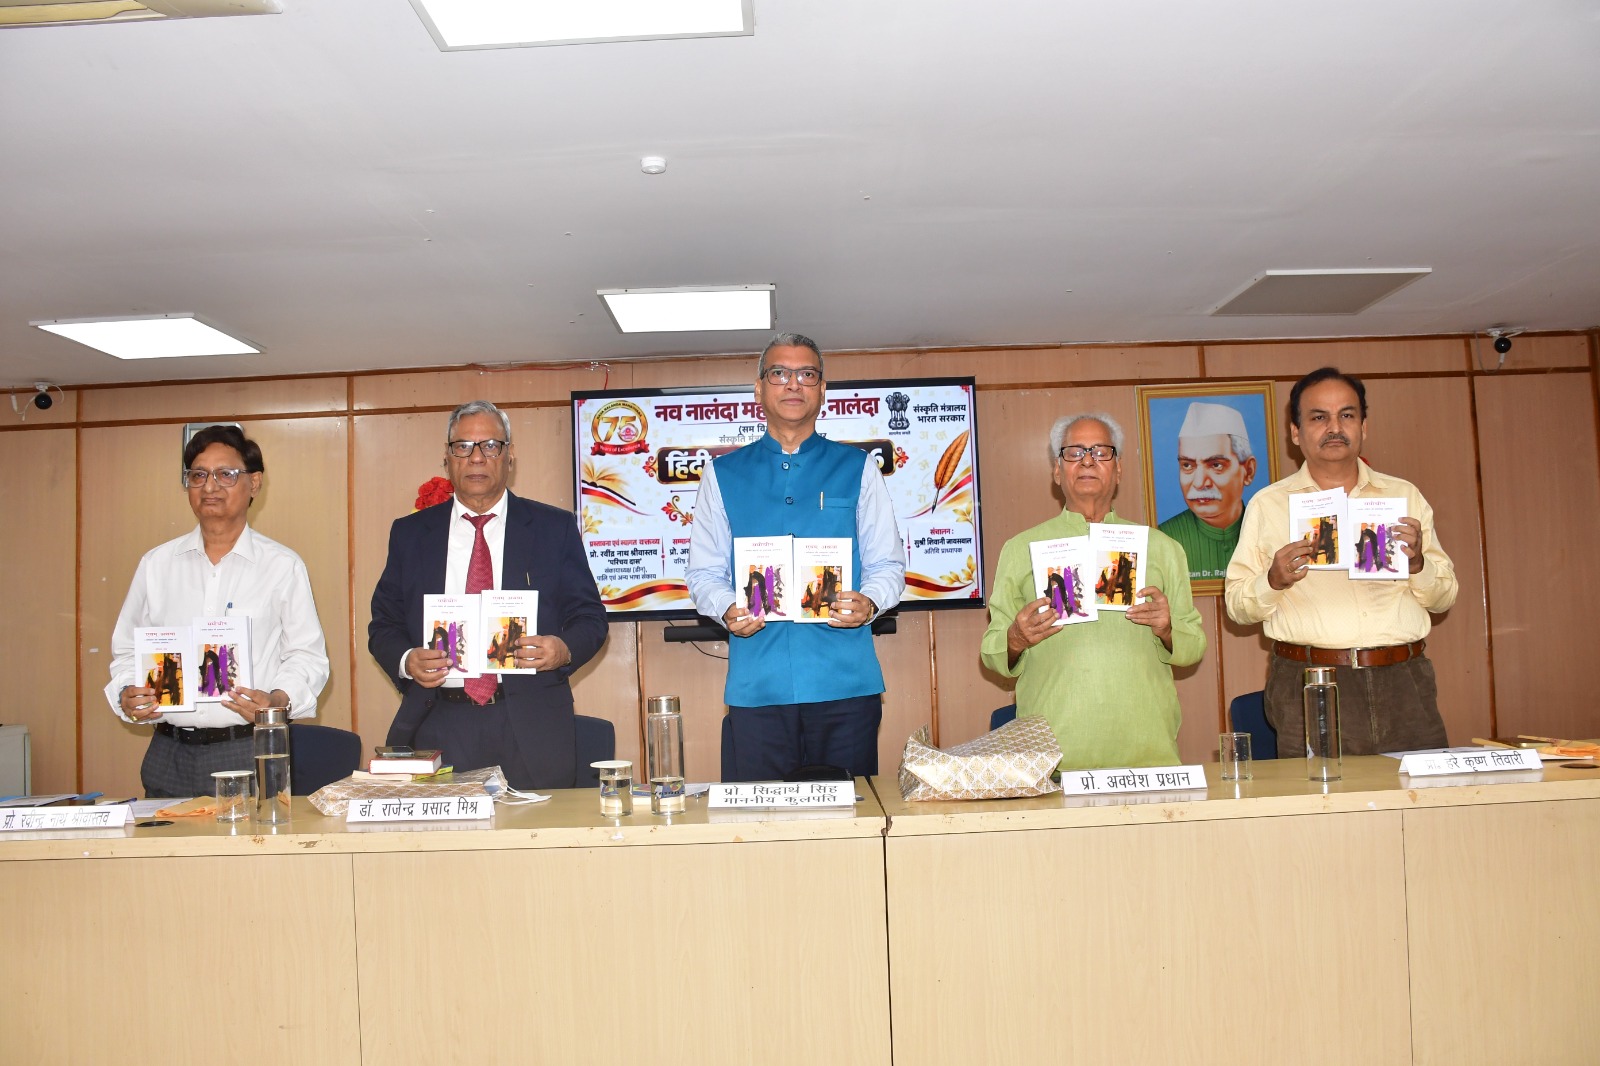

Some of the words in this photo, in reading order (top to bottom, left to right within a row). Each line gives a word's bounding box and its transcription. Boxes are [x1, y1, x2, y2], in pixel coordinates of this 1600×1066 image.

[654, 404, 682, 422] नव
[685, 397, 739, 422] नालंदा
[912, 402, 939, 415] संस्कृति
[940, 402, 967, 413] मंत्रालय
[917, 415, 938, 423] भारत
[938, 415, 966, 423] सरकार
[719, 434, 746, 445] संस्कृति
[665, 448, 712, 480] हिंदी
[1463, 755, 1488, 772] कृष्ण
[1490, 750, 1526, 768] तिवारी
[1080, 771, 1101, 791] प्रो.
[1106, 769, 1150, 789] अवधेश
[1155, 771, 1192, 789] प्रधान
[753, 784, 801, 796] सिद्धार्थ
[810, 783, 839, 795] सिंह
[359, 799, 376, 817] डॉ.
[382, 798, 416, 817] राजेन्द्र
[421, 801, 452, 816] प्रसाद
[457, 796, 479, 815] मिश्र
[723, 795, 776, 805] माननीय
[784, 794, 837, 806] कुलपति
